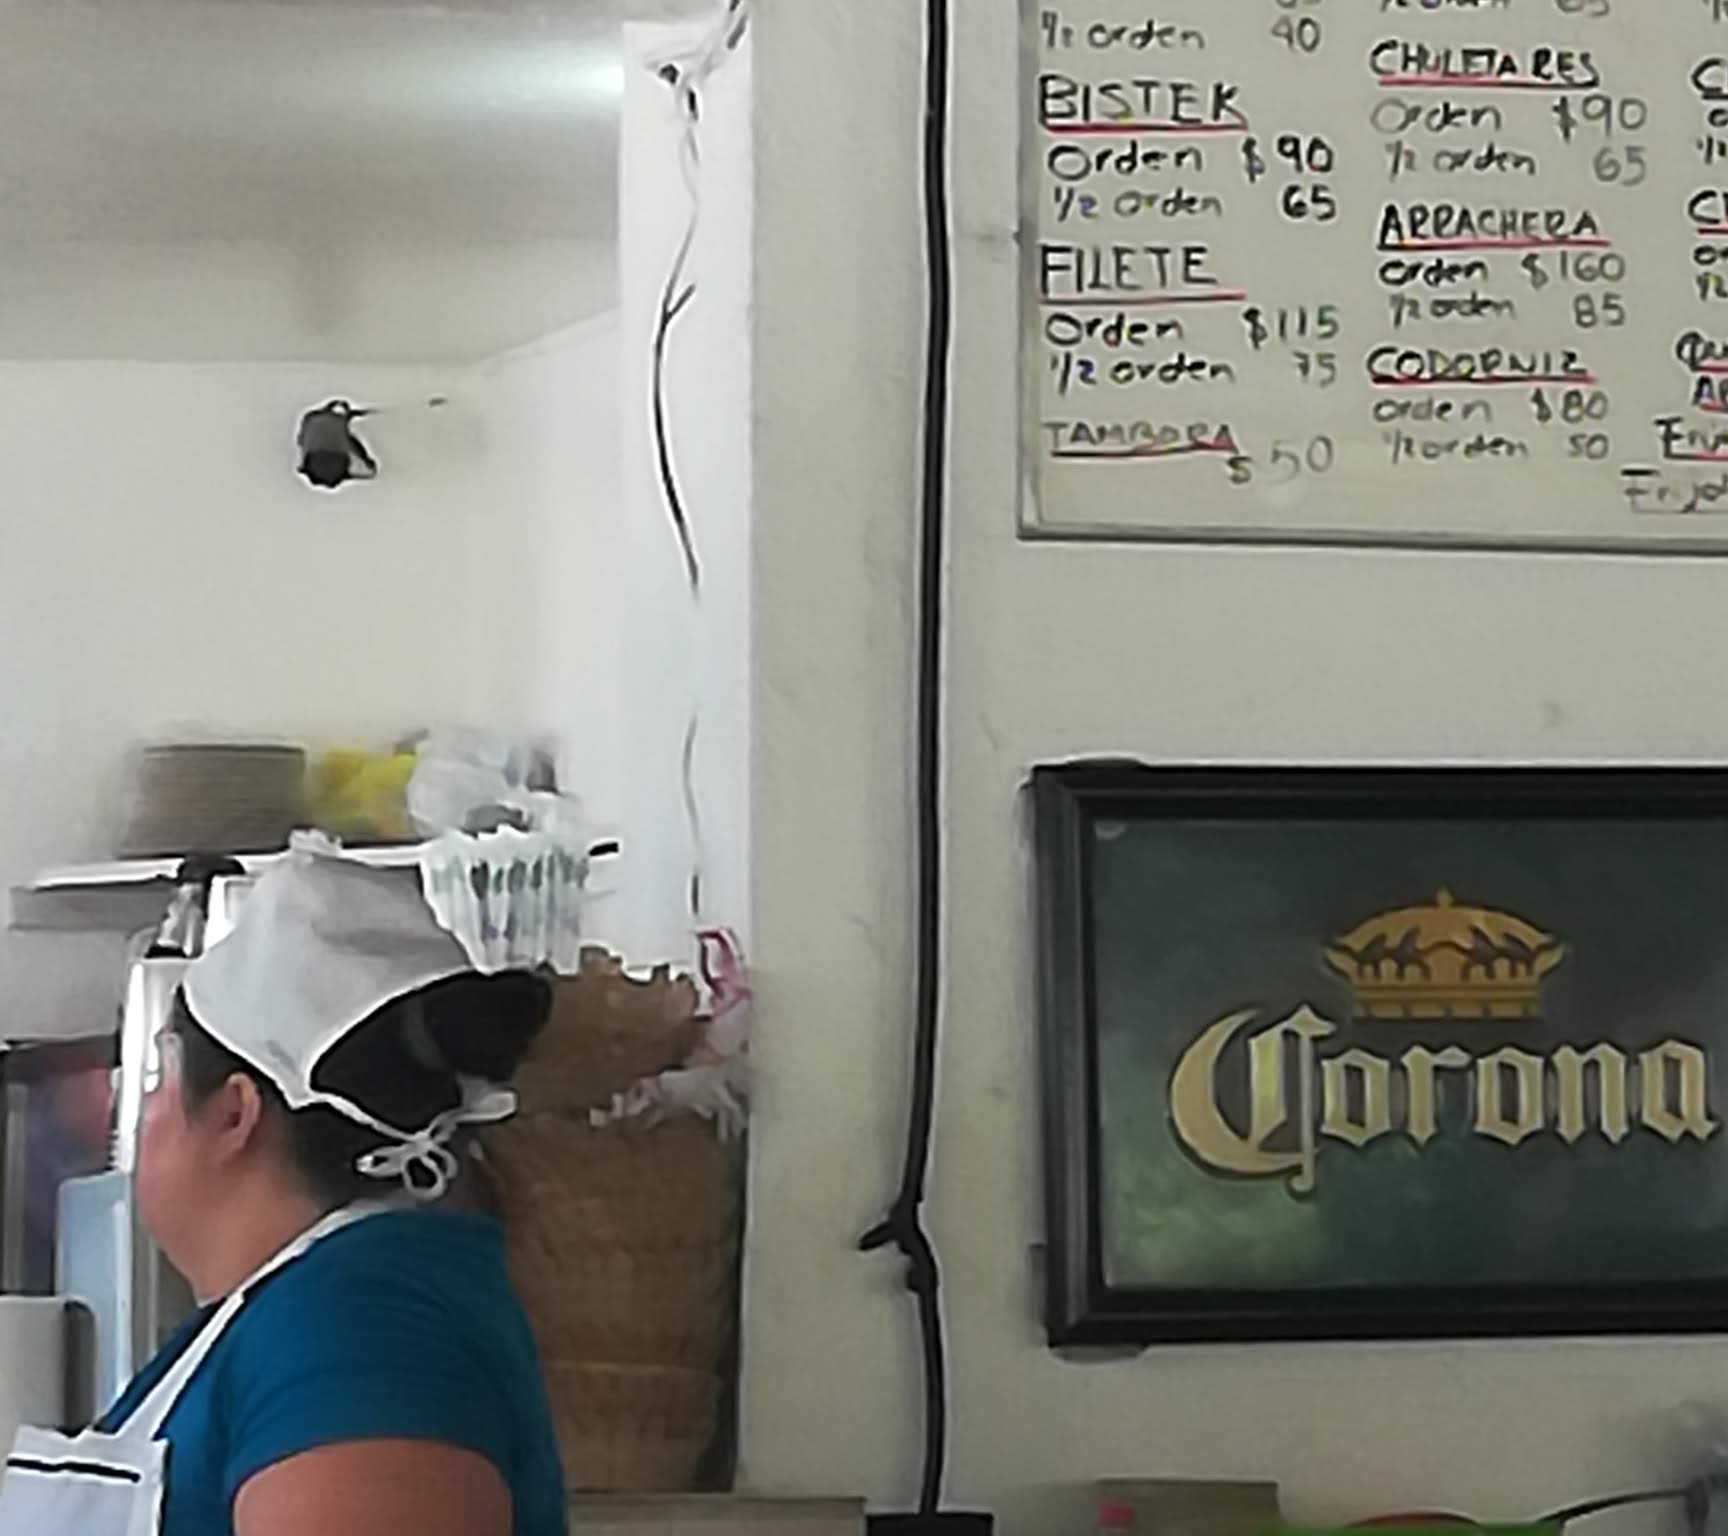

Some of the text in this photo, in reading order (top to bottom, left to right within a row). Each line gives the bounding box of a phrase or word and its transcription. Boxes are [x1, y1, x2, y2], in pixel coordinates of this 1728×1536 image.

[1088, 19, 1205, 50] orden
[1271, 16, 1321, 52] 40
[1039, 74, 1249, 127] BISTEK
[1048, 139, 1203, 181] Orden
[1593, 146, 1648, 186] 65
[1282, 184, 1336, 220] 65
[1378, 204, 1599, 248] ARRACHERA
[1040, 244, 1218, 295] FILETE
[1573, 292, 1626, 329] 85
[1109, 353, 1235, 384] orden
[1293, 352, 1337, 389] 75
[1366, 346, 1588, 379] CODORNIZ
[1568, 433, 1609, 460] 50
[1168, 1002, 1722, 1196] Corona
